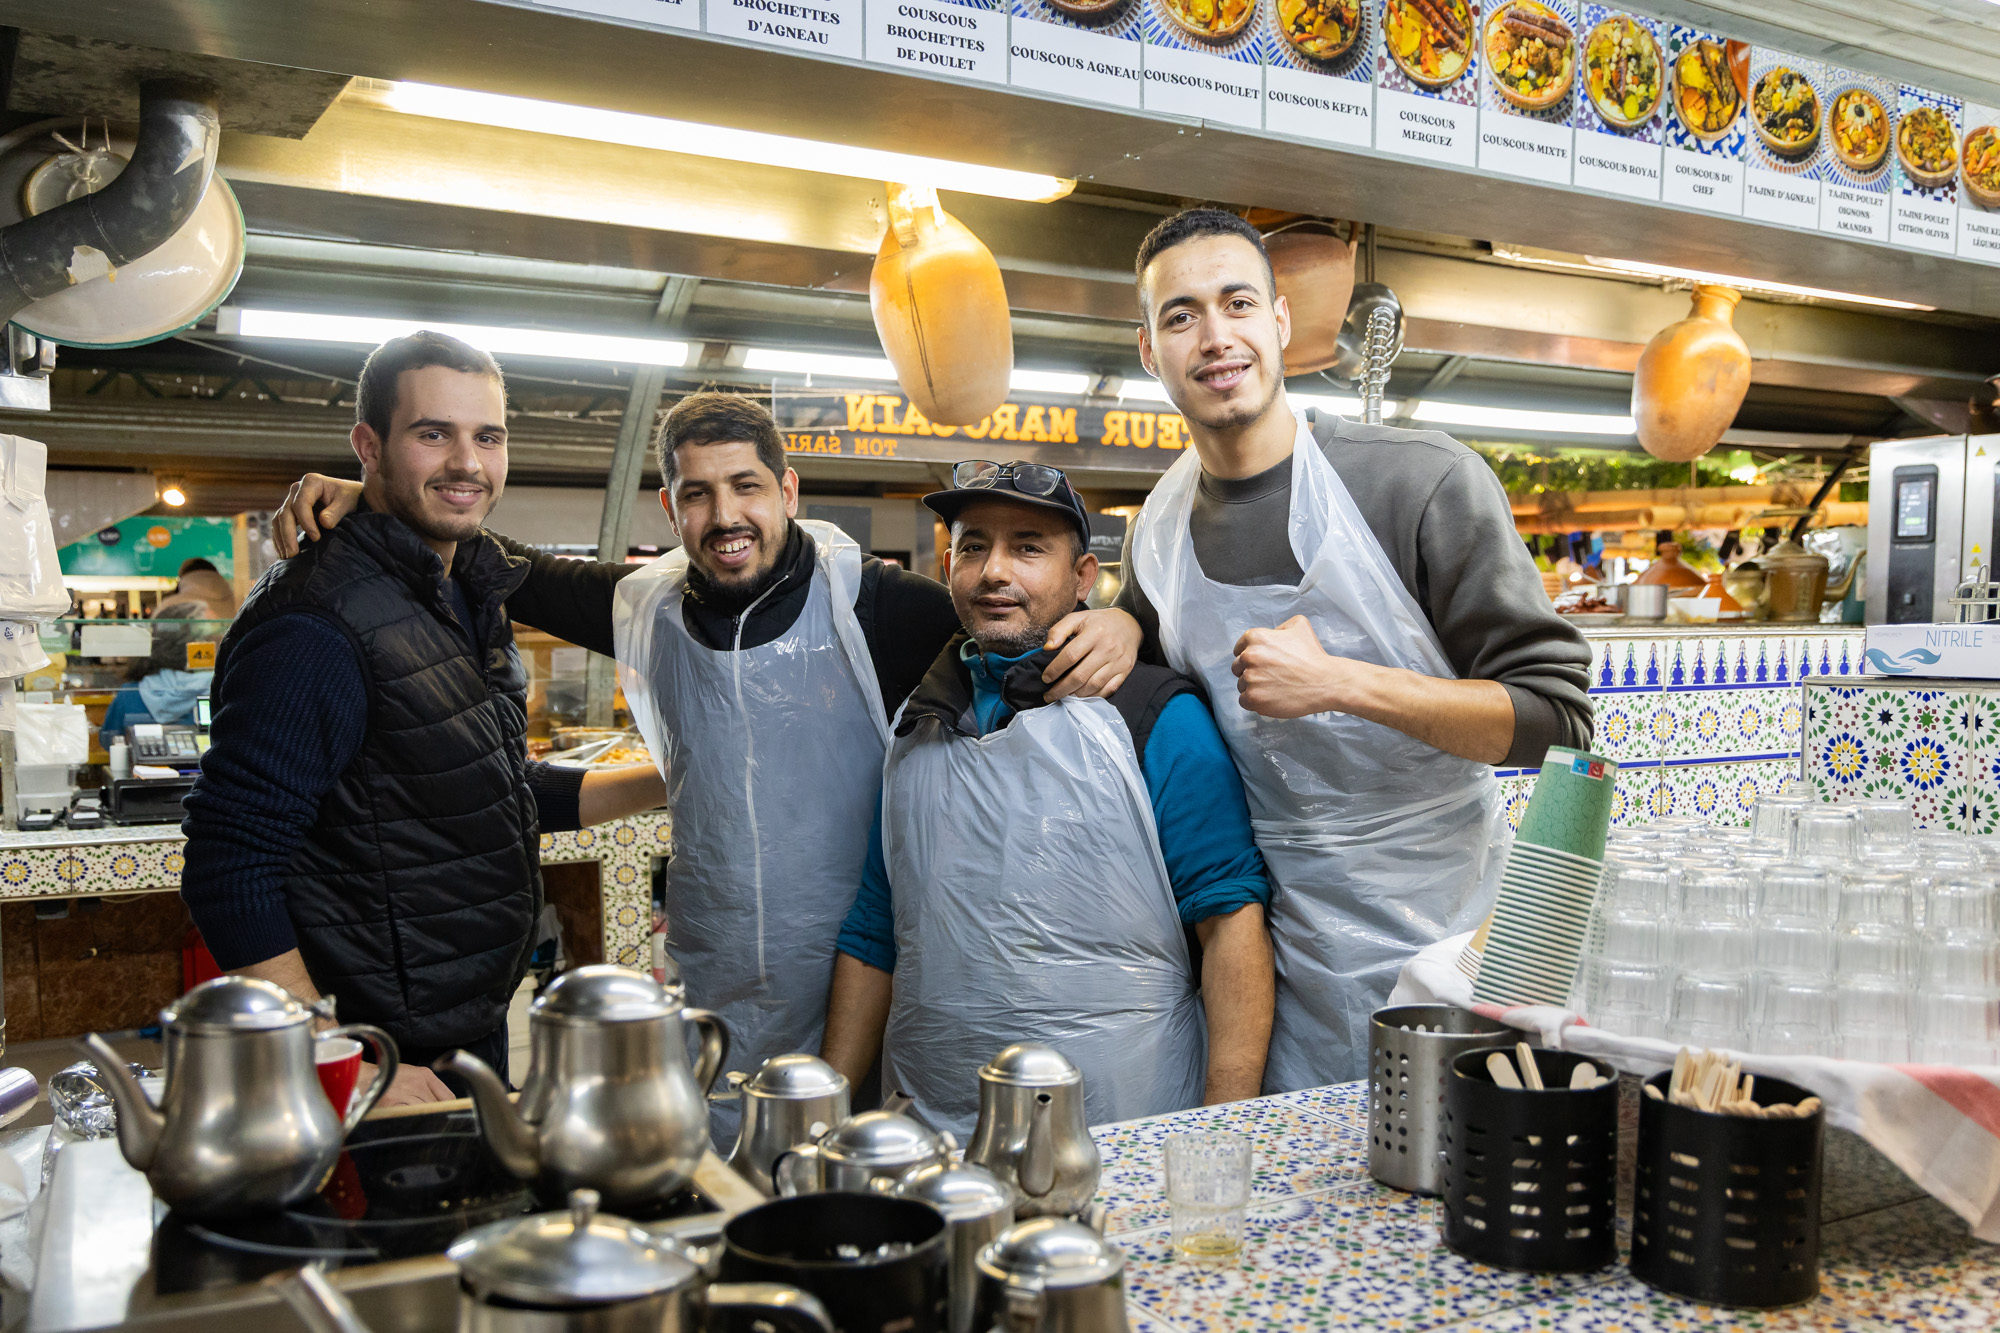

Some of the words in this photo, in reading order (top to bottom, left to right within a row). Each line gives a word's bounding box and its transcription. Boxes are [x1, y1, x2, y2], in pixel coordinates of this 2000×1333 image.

[733, 0, 841, 25] BROCHETTES
[898, 4, 978, 30] COUSCOUS
[747, 19, 829, 44] D'AGNEAU
[886, 23, 985, 52] BROCHETTES
[896, 47, 917, 61] DE
[918, 51, 976, 71] POULET
[1010, 45, 1084, 70] COUSCOUS
[1086, 61, 1140, 81] AGNEAU
[1143, 69, 1213, 90] COUSCOUS
[1214, 81, 1260, 100] POULET
[1268, 90, 1330, 110] COUSCOUS
[1332, 102, 1368, 117] KEFTA
[1399, 110, 1456, 130] COUSCOUS
[1402, 129, 1453, 147] MERGUEZ
[1482, 133, 1535, 153] COUSCOUS
[1536, 144, 1568, 158] MIXTE
[1579, 155, 1628, 172] COUSCOUS
[1629, 165, 1659, 179] ROYAL
[1675, 164, 1720, 181] COUSCOUS
[1721, 173, 1733, 184] DU
[1692, 184, 1716, 196] CHEF
[1747, 184, 1776, 198] TAJINE
[1777, 189, 1817, 205] D'AGNEAU
[1828, 188, 1854, 201] TAJINE
[1855, 194, 1884, 207] POULET
[1836, 221, 1873, 234] AMANDES
[1897, 208, 1923, 221] TAJINE
[1923, 213, 1950, 226] POULET
[1966, 223, 1990, 235] TAJINE
[1925, 630, 1984, 648] NITRILE
